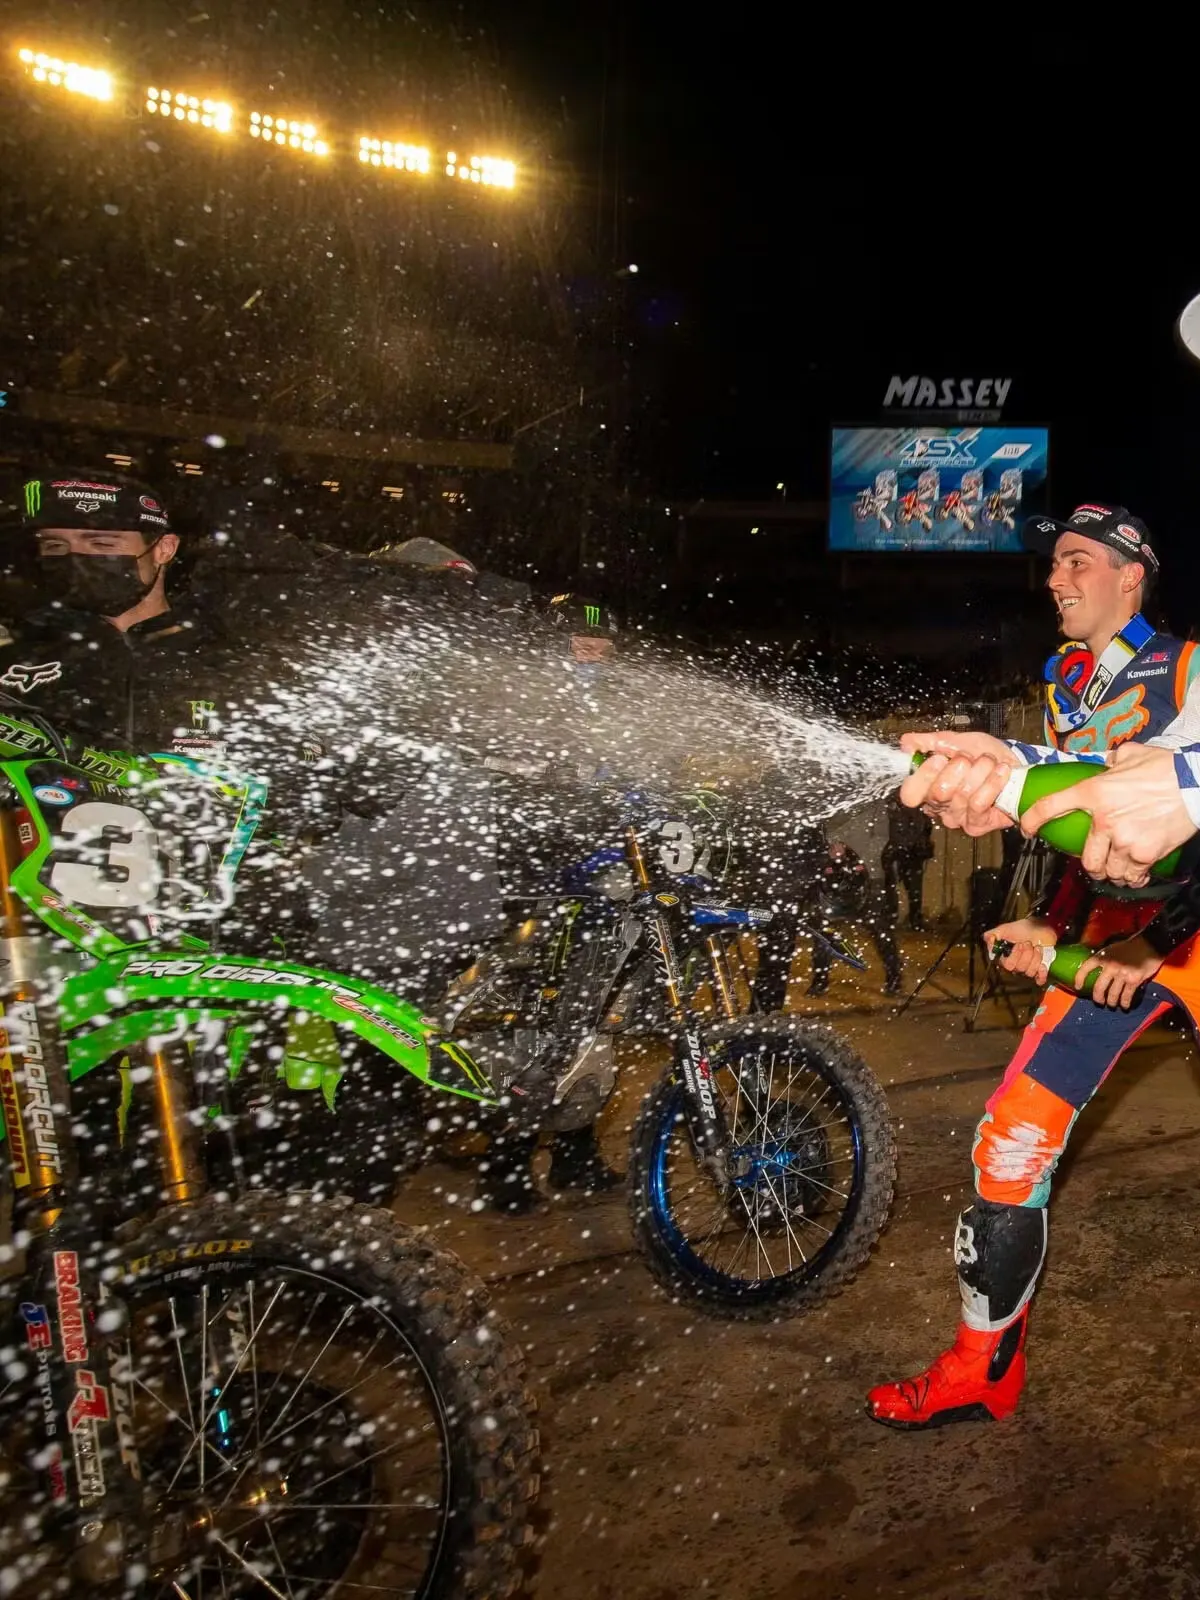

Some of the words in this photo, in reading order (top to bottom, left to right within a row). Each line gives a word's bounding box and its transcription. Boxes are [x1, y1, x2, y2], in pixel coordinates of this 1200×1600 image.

[883, 376, 1012, 407] MASSEY
[58, 489, 116, 502] Kawasaki
[1109, 532, 1139, 553] DUNLOP
[1121, 526, 1138, 540] BELL
[1127, 666, 1168, 680] Kawasaki
[119, 960, 204, 978] PRO
[199, 963, 365, 999] CIRCUIT
[682, 1058, 697, 1094] BRAKING
[54, 1250, 89, 1364] BRAKING
[36, 1350, 57, 1436] PISTONS
